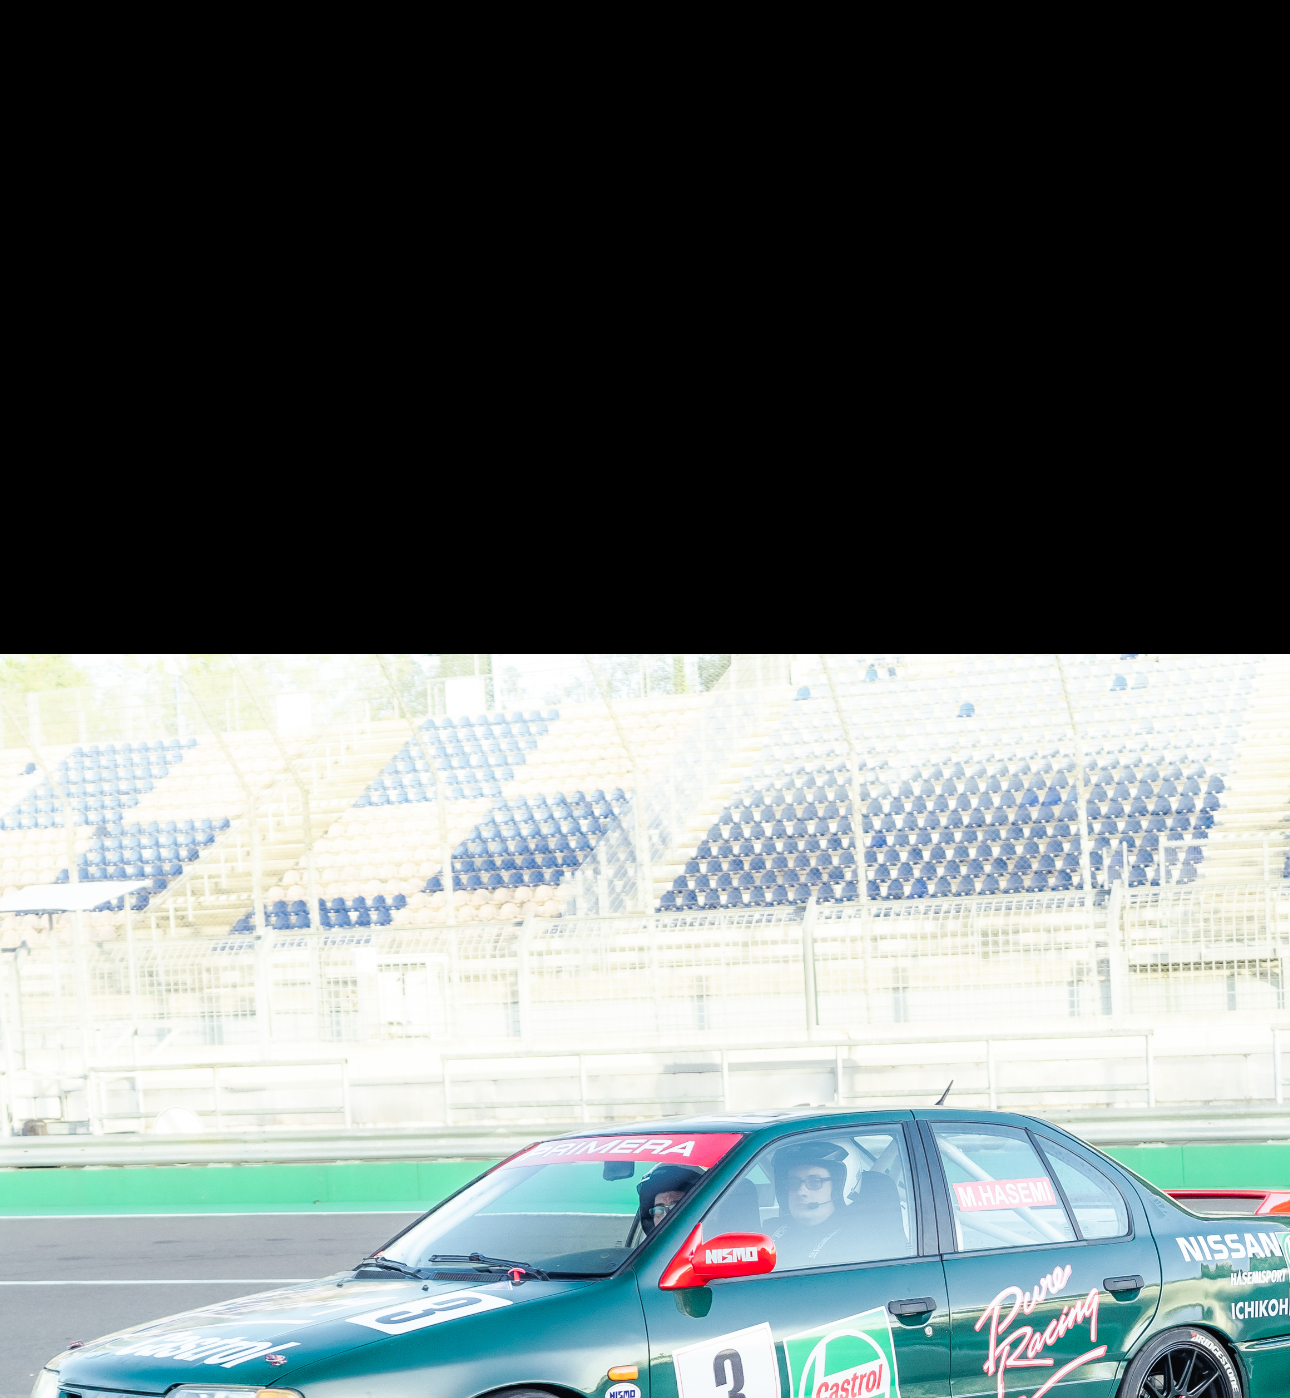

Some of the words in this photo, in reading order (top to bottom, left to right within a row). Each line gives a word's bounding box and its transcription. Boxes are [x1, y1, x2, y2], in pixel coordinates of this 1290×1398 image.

[521, 1138, 696, 1161] PRIMERA
[957, 1181, 1053, 1207] M.HASEMI
[705, 1246, 759, 1264] NISMO
[1175, 1233, 1283, 1262] NISSAN
[1230, 1269, 1287, 1286] HASEMISPORT
[374, 1296, 483, 1325] 3
[974, 1264, 1073, 1376] Pure
[1231, 1297, 1290, 1320] ICHIKOH
[1191, 1332, 1240, 1393] BRIDGESTONE
